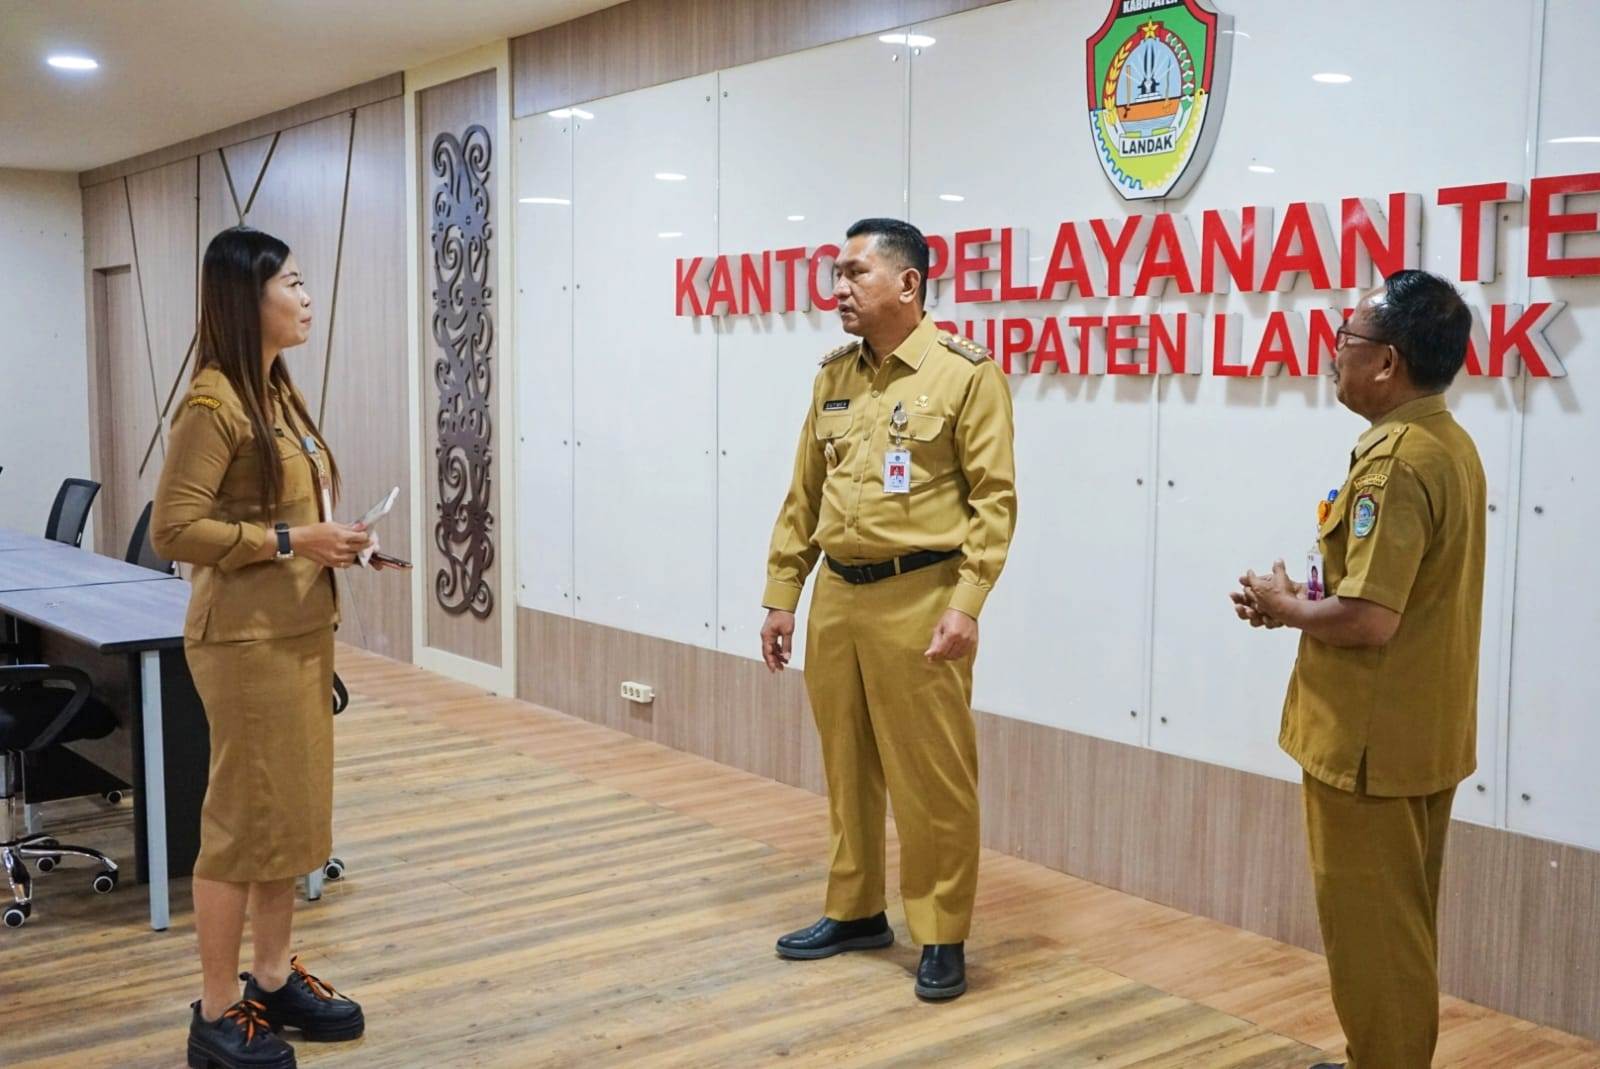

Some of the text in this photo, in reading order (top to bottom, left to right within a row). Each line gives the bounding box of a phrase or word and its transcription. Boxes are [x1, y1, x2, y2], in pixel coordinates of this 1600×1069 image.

[1122, 135, 1173, 154] LANDAK
[675, 244, 841, 317] KANTO
[1212, 302, 1552, 378] LANK
